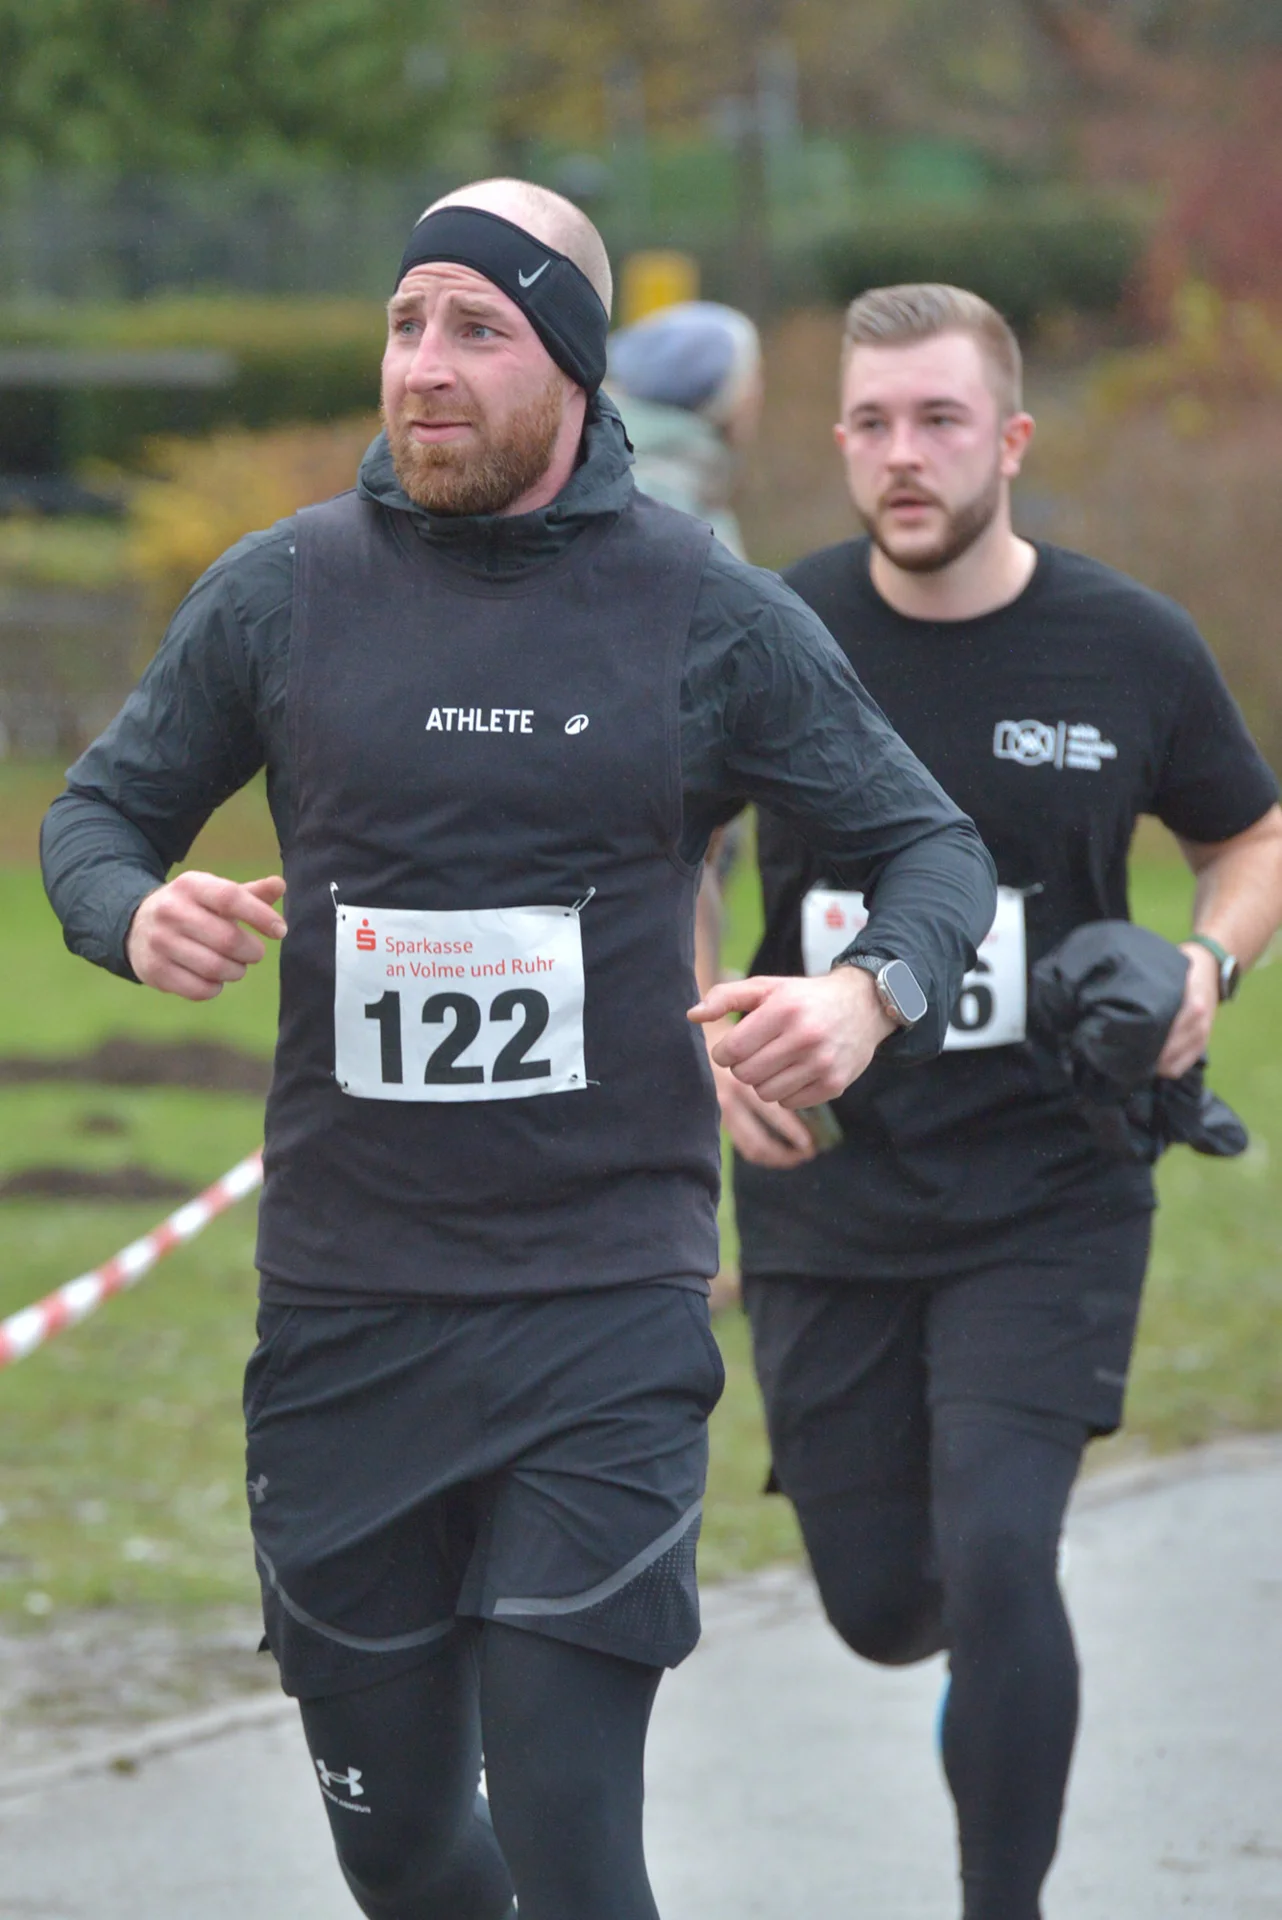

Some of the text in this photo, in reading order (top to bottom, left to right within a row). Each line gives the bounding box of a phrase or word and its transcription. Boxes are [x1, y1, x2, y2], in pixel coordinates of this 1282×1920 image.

[425, 707, 535, 733] ATHLETE
[385, 936, 473, 955] Sparkasse
[386, 956, 555, 978] an Volme und Ruhr
[364, 988, 551, 1085] 122
